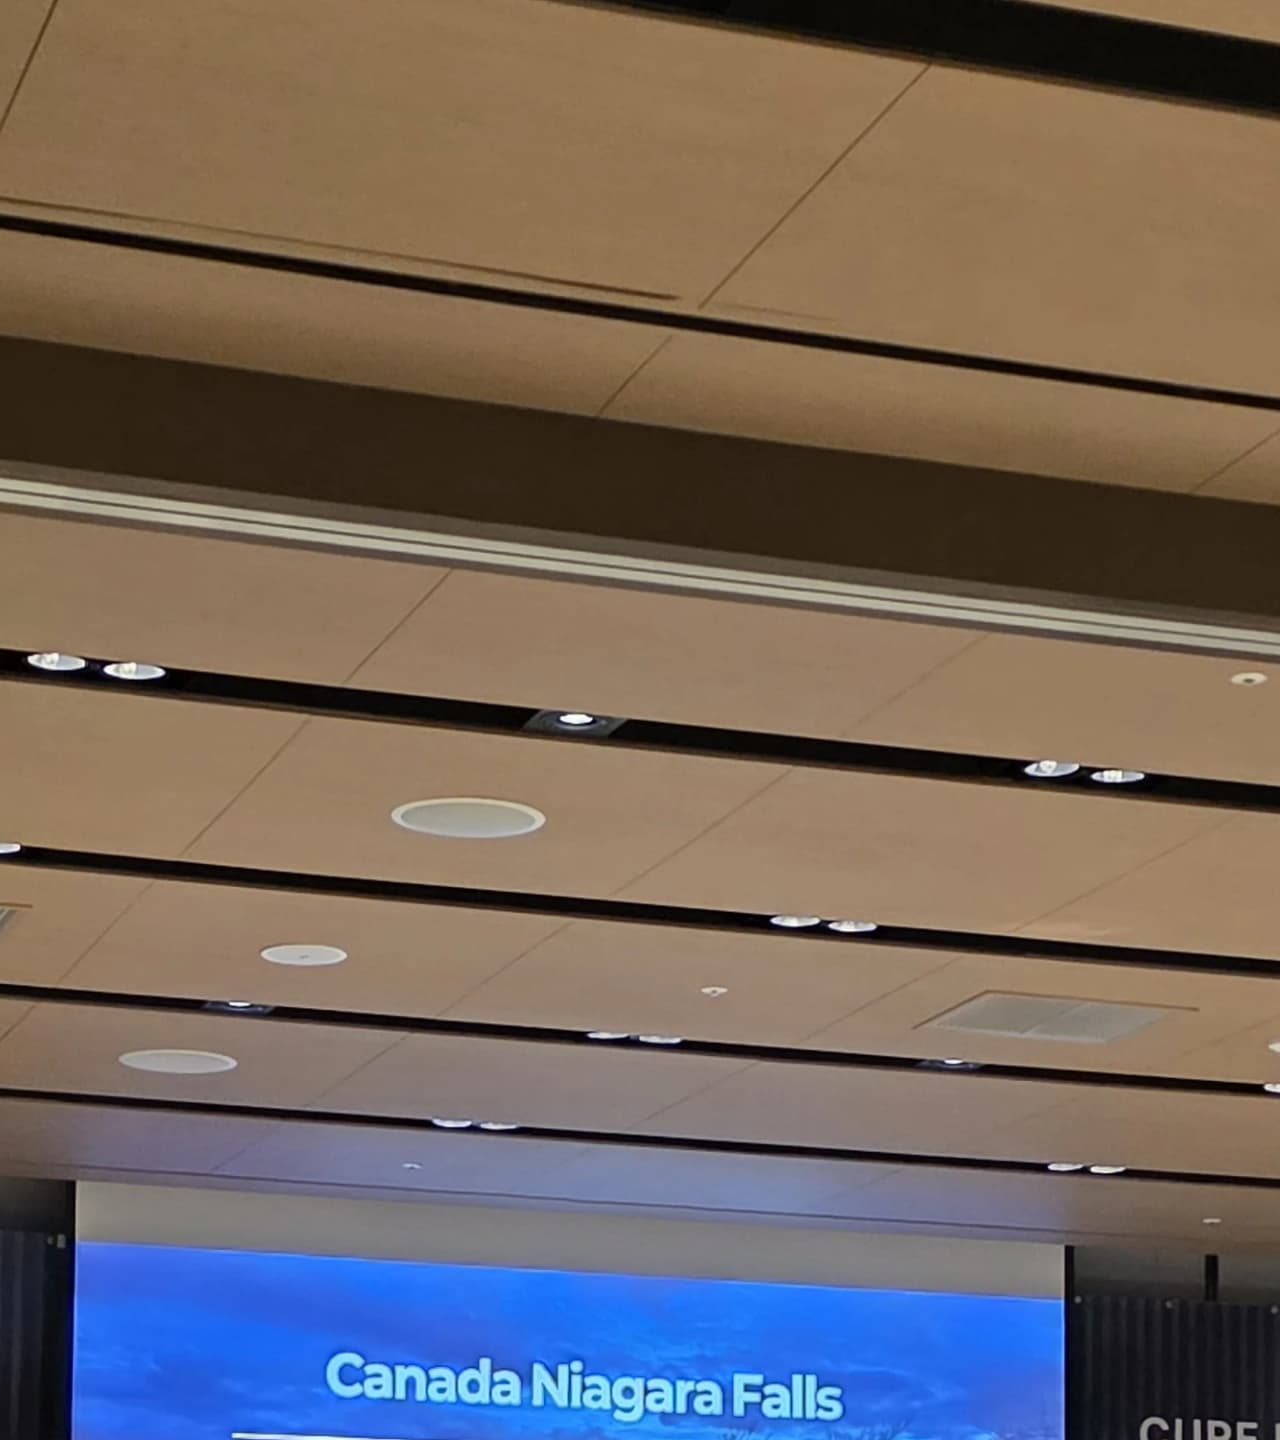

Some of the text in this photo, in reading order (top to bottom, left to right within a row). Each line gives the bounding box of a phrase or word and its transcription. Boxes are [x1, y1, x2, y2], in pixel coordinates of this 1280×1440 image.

[325, 1352, 844, 1422] Canada Niagara Falls
